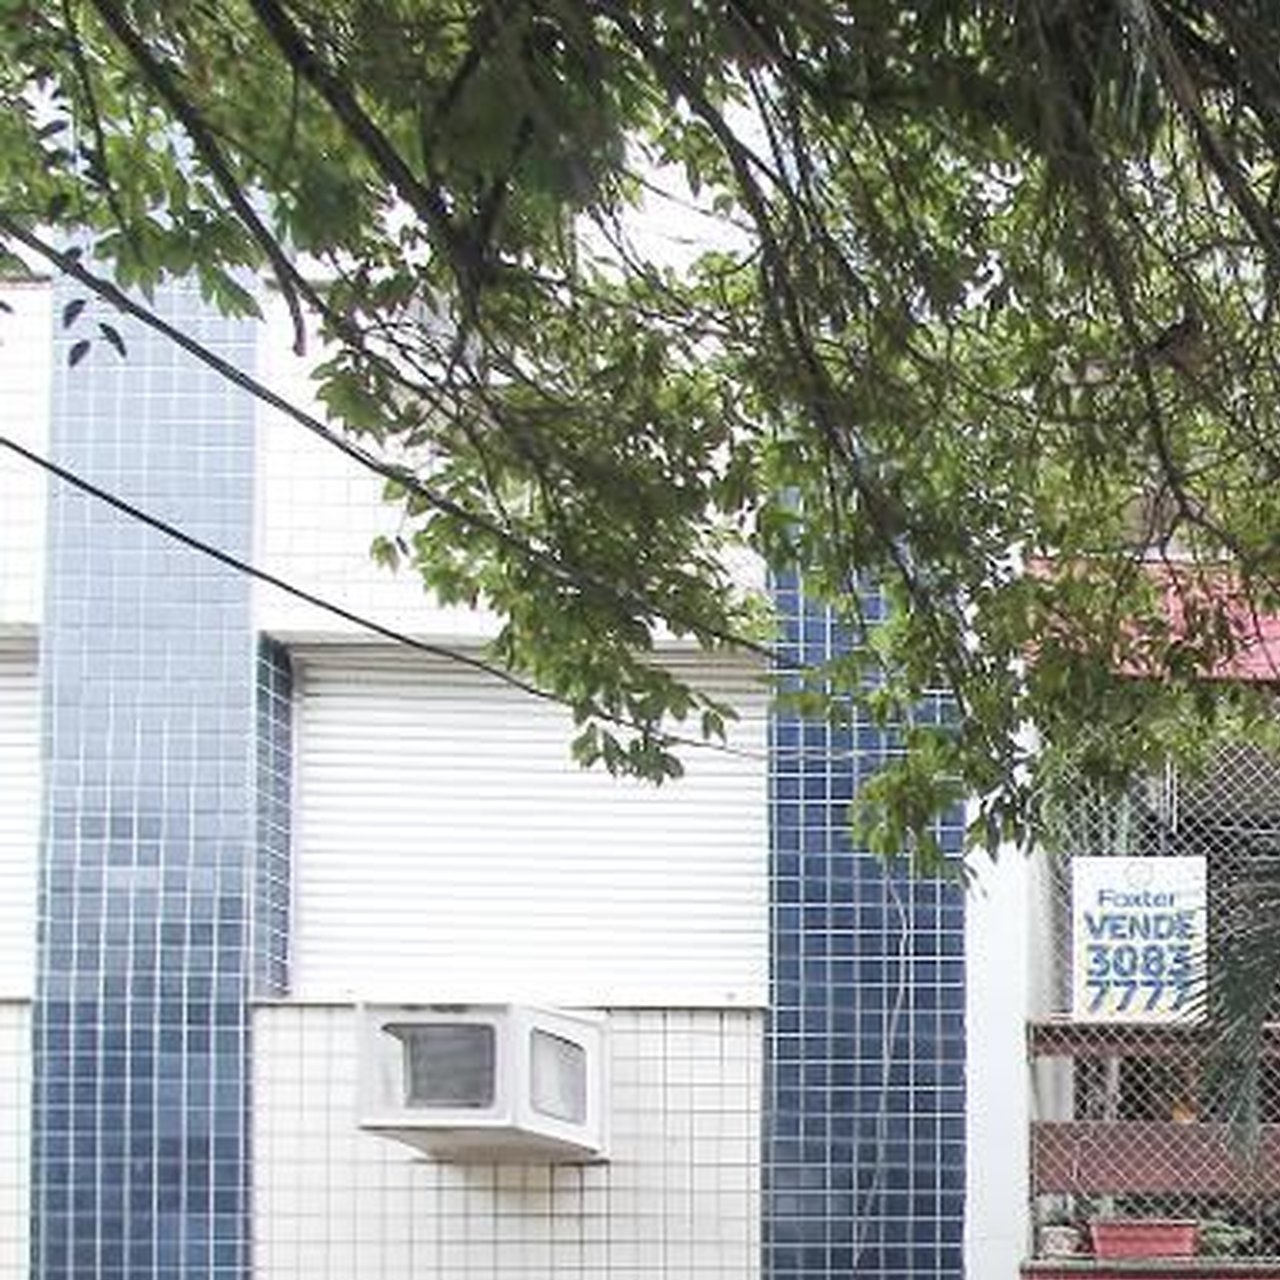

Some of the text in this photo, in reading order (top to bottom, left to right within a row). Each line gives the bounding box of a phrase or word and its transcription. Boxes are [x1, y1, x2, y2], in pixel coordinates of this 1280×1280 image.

[1098, 889, 1175, 908] Foxter
[1083, 912, 1196, 940] VENDE
[1084, 944, 1194, 978] 3083
[1084, 979, 1194, 1013] 7777
